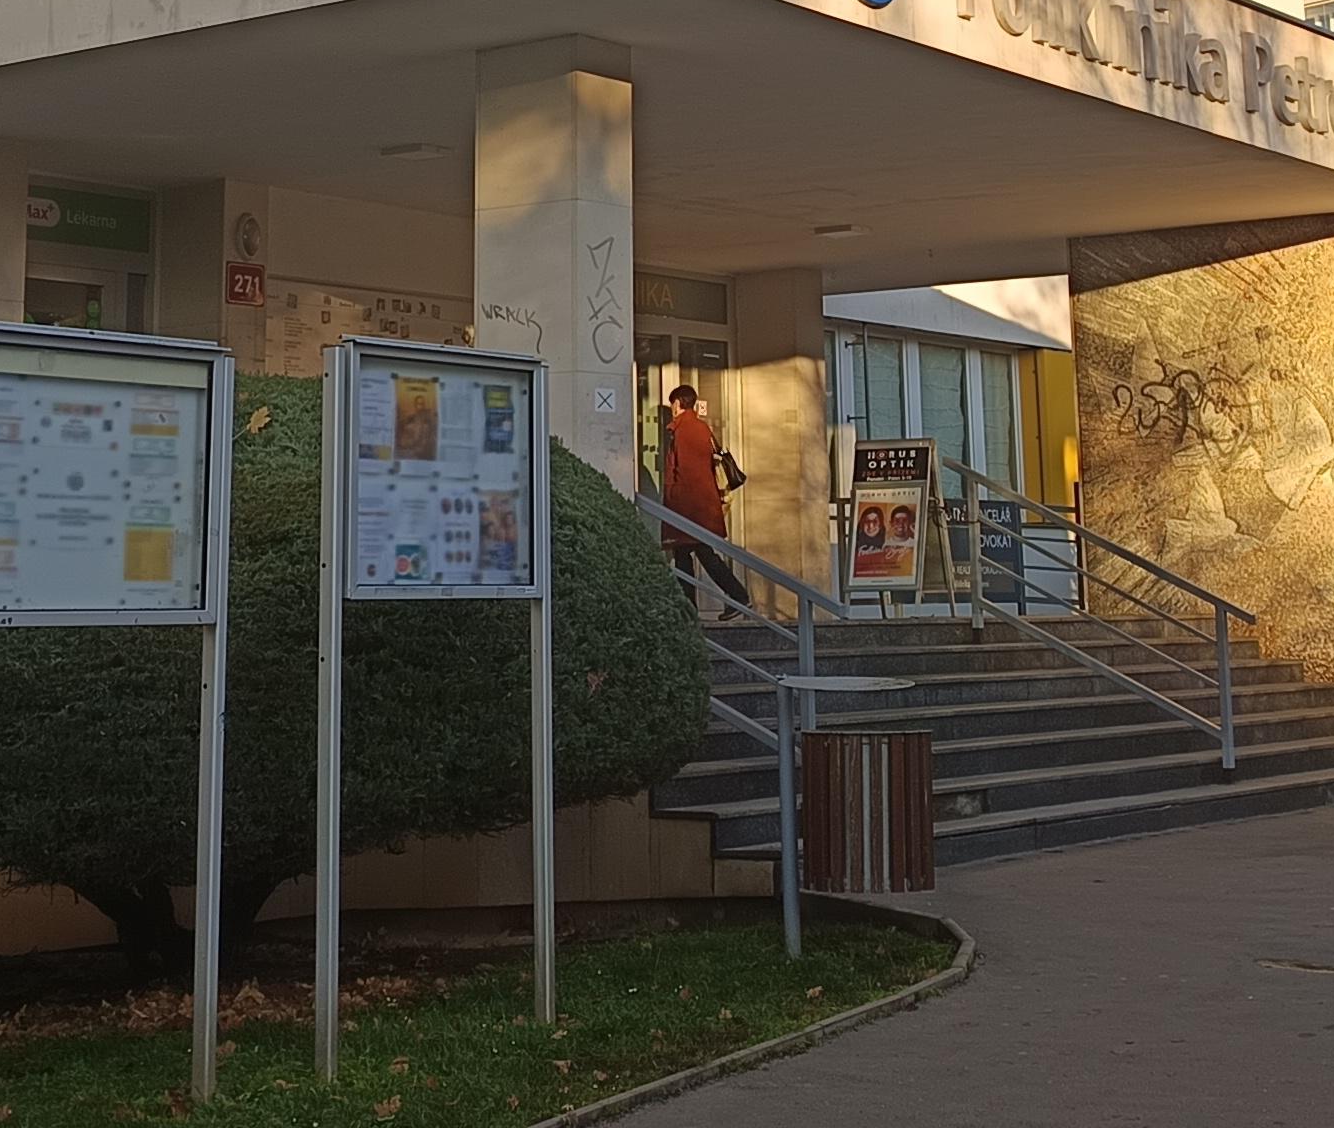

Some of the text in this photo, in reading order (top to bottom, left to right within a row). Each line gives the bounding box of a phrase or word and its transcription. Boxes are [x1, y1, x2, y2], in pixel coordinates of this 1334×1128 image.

[234, 273, 260, 297] 271
[867, 449, 917, 460] HORUS
[868, 459, 914, 469] OPTIK
